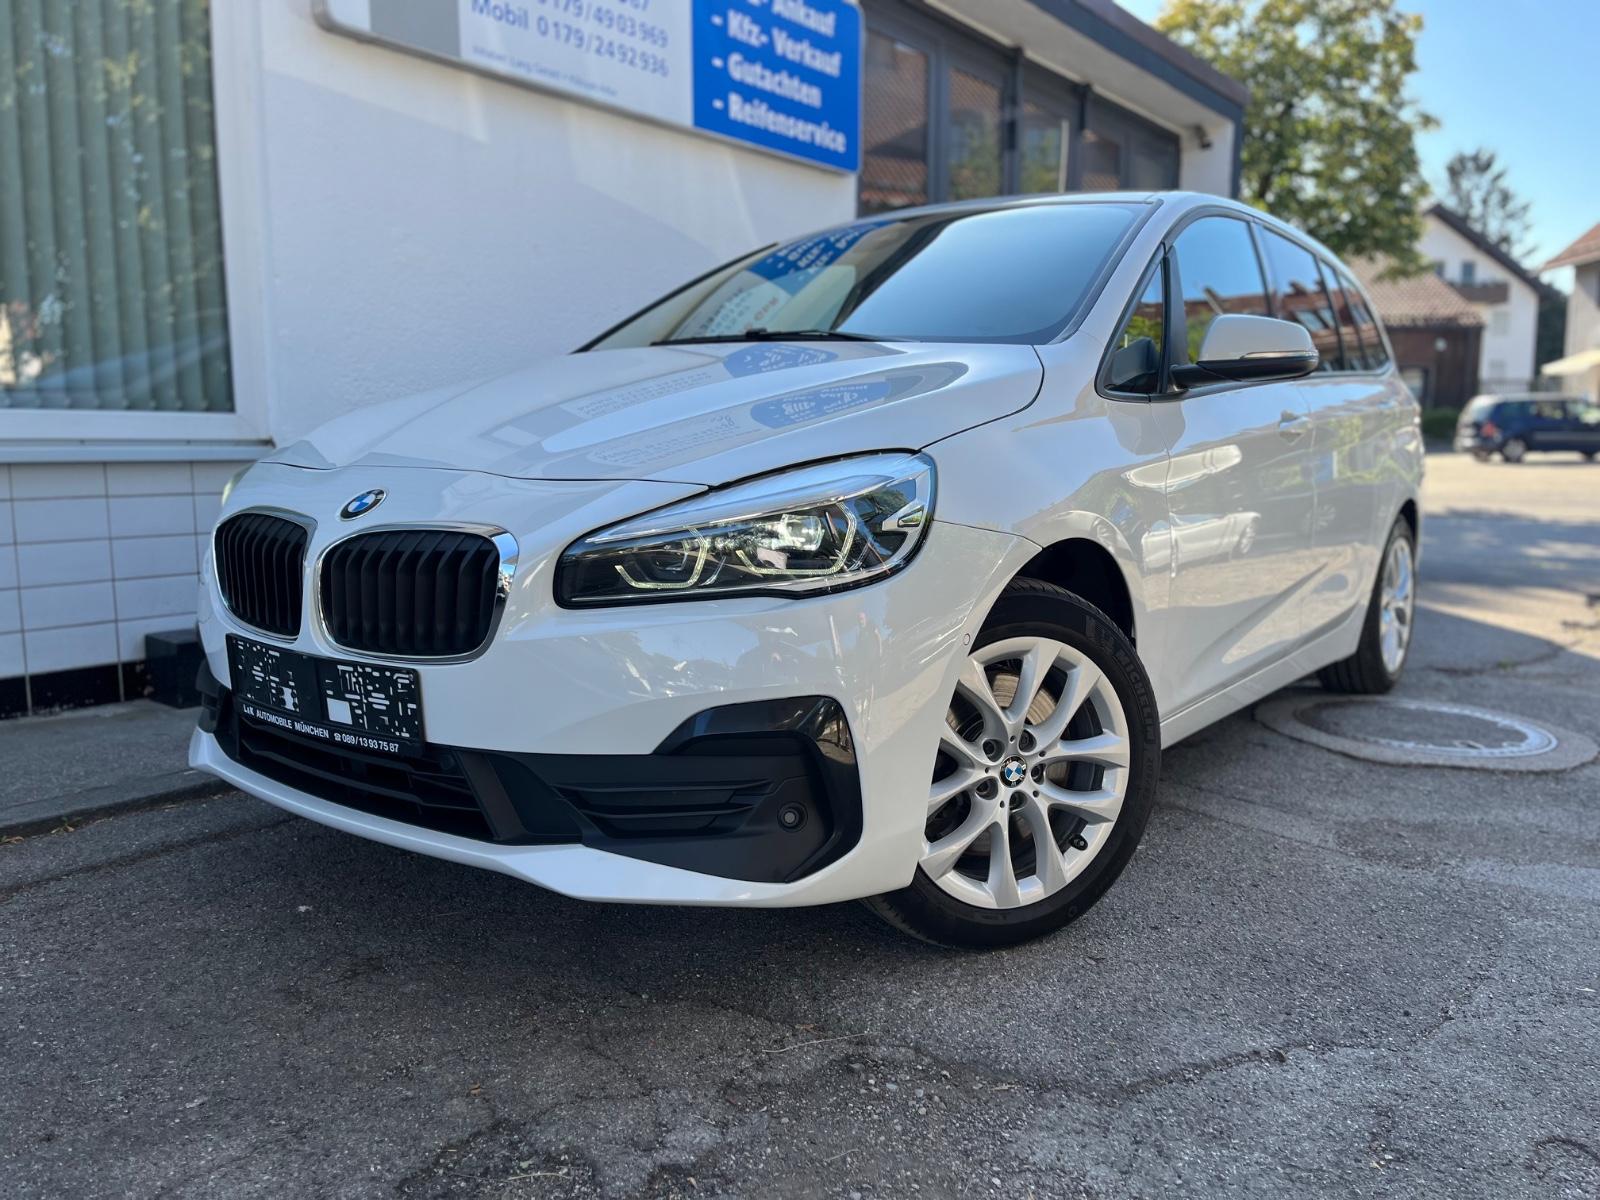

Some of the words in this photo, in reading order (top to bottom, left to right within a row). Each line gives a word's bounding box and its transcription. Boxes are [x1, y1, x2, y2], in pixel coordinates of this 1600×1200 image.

[472, 0, 529, 30] Mobil
[539, 0, 669, 48] 79/4903969
[771, 26, 842, 78] Verkauf
[728, 52, 823, 109] Gutachten
[728, 91, 847, 154] Reifenservice
[1115, 648, 1156, 741] MICHELIN
[256, 709, 292, 729] AUTOMOBILE
[294, 721, 329, 739] MÜNCHEN
